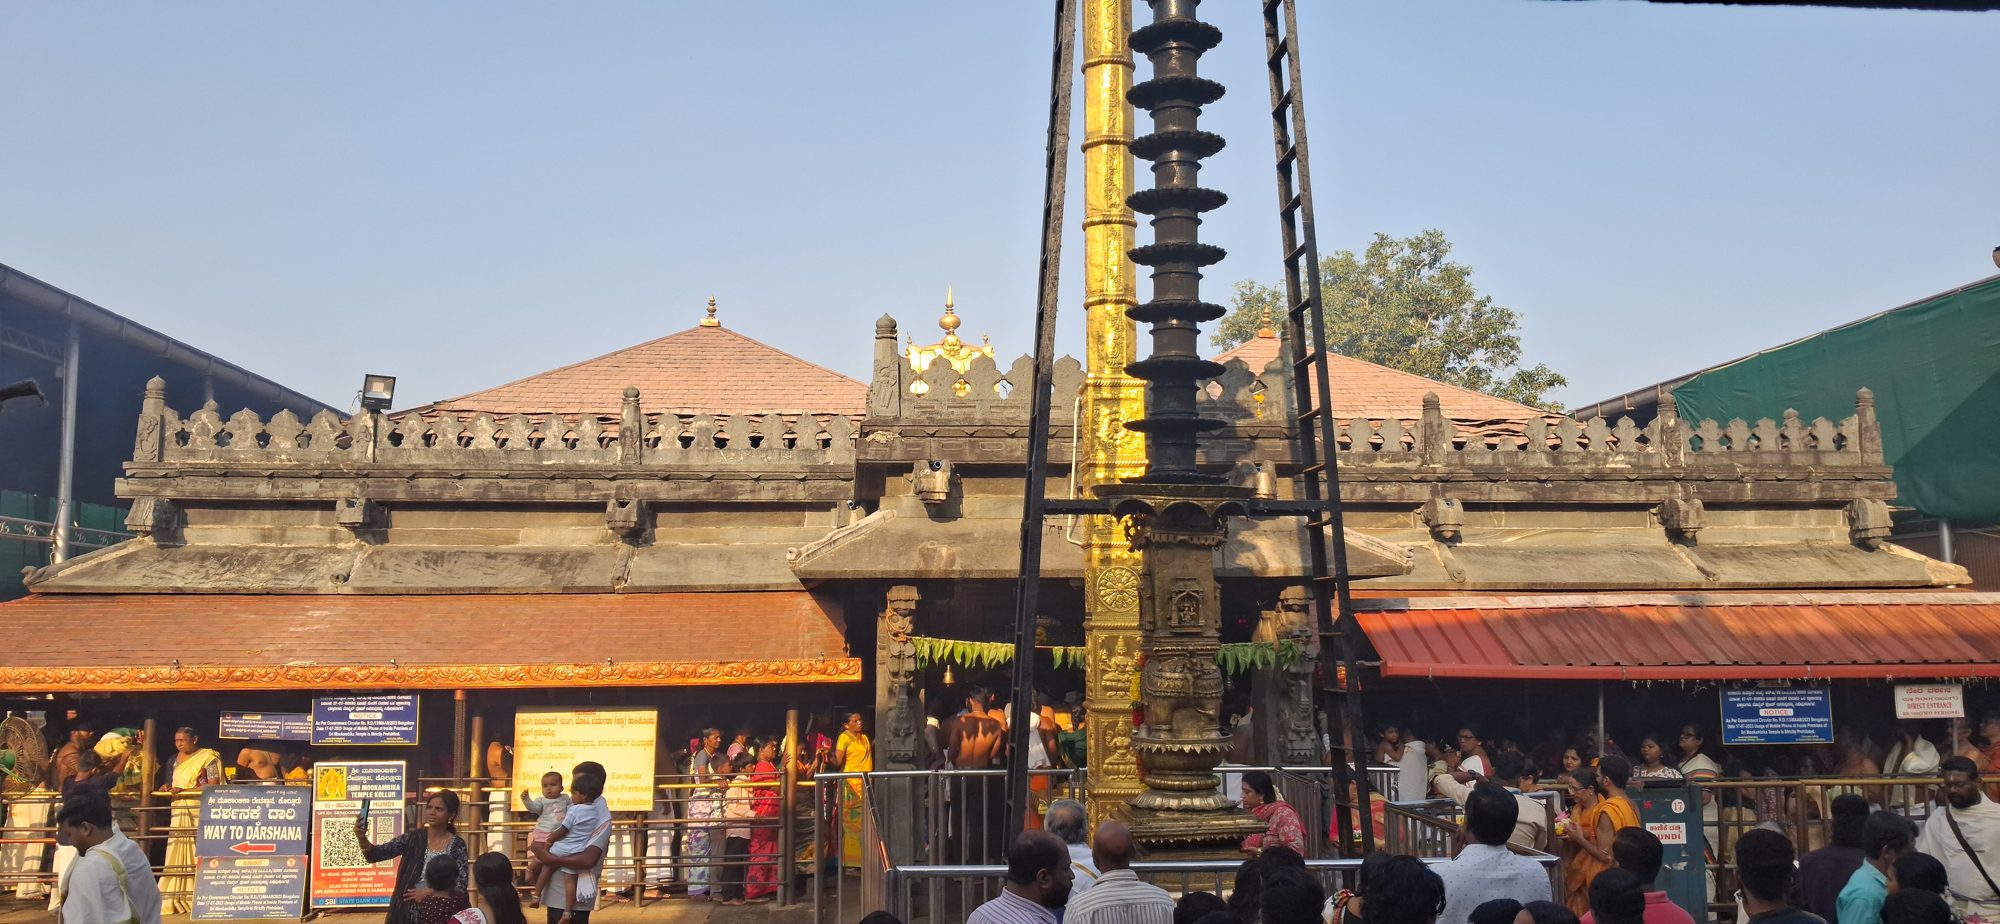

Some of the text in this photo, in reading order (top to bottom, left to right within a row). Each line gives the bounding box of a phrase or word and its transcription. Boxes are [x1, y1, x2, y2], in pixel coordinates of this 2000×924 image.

[1674, 802, 1682, 811] 17
[210, 805, 296, 826] ದರ್ಶನಕ್ಕೆ ದಾರಿ
[204, 825, 302, 840] WAY TO DARSHANA
